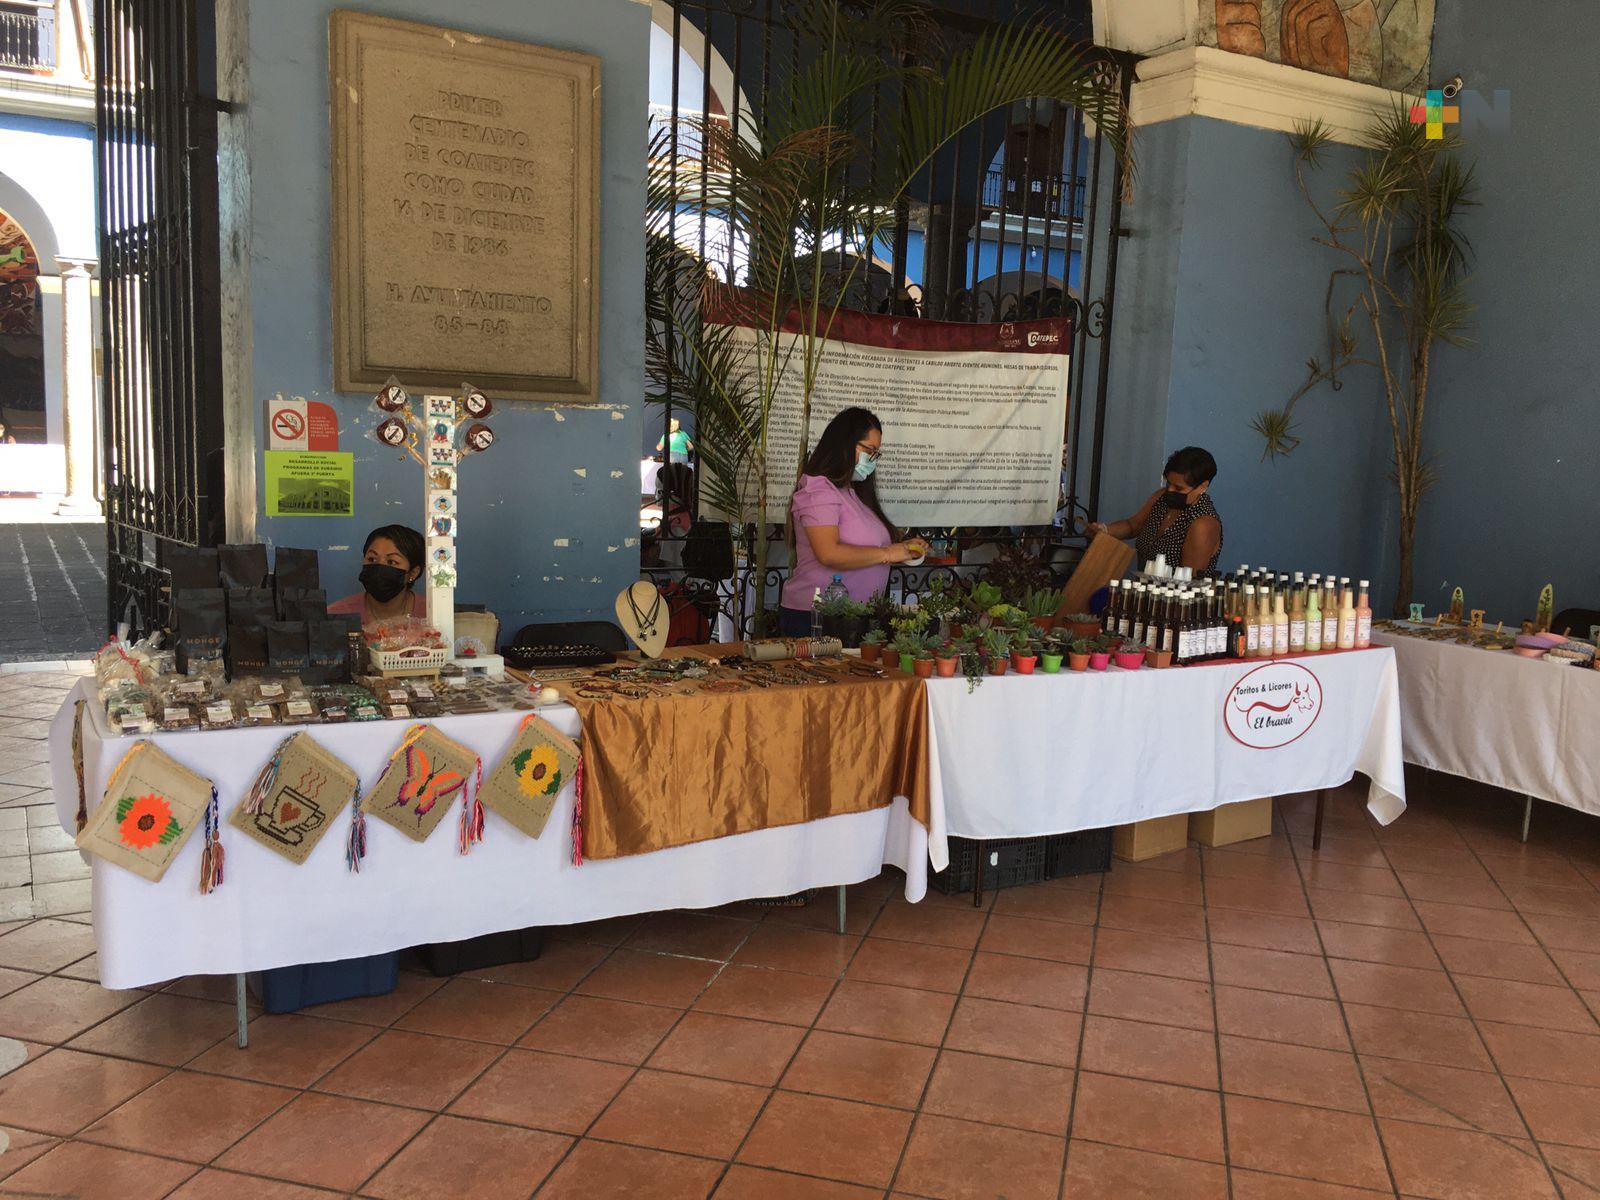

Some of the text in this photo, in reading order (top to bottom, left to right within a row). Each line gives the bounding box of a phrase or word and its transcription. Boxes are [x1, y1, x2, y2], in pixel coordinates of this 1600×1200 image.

[438, 90, 503, 116] PRIMER
[409, 114, 530, 148] CENTENARIO
[404, 142, 537, 177] DE COATEPEC
[403, 171, 537, 205] COMO CIUDAD
[421, 201, 446, 222] DE
[453, 206, 545, 234] DICIEMBRE
[432, 231, 457, 250] DE
[410, 285, 551, 313] AYUNTAMIENTO
[1235, 682, 1292, 695] Toritos & Licores
[1253, 716, 1264, 729] El
